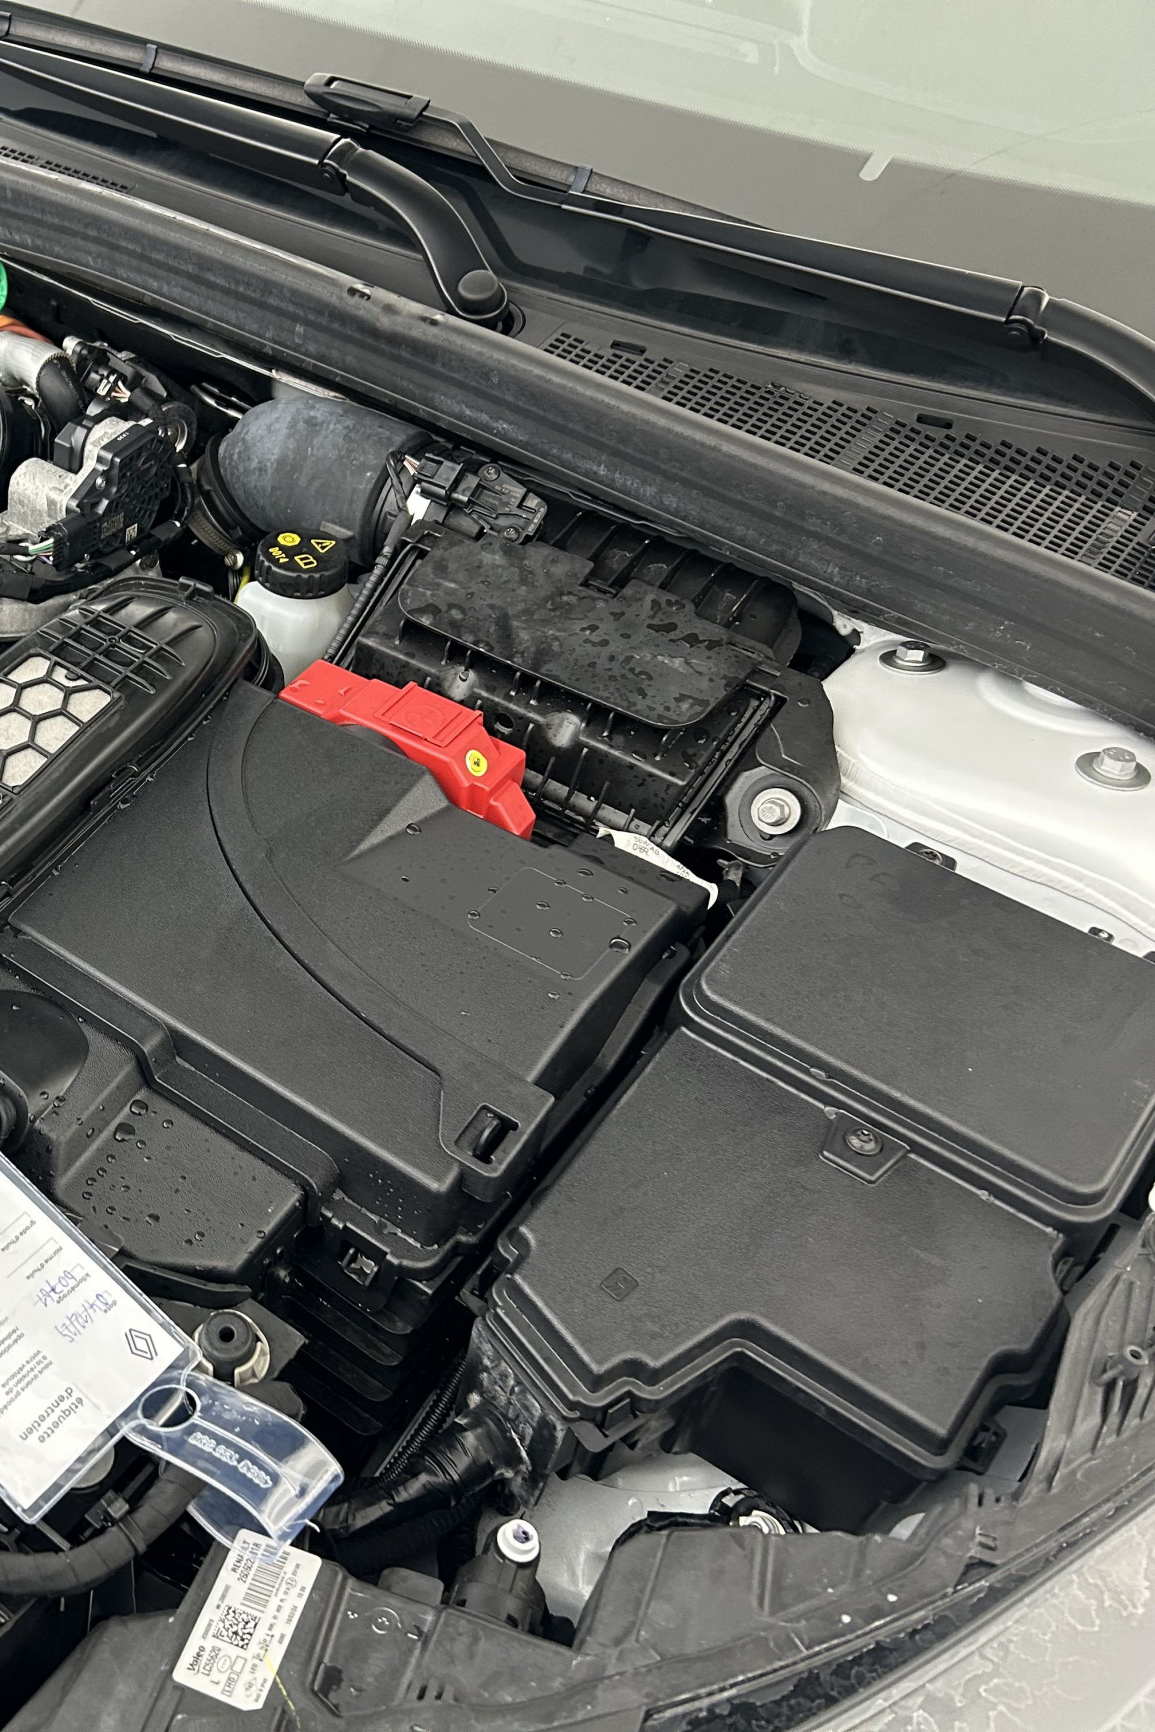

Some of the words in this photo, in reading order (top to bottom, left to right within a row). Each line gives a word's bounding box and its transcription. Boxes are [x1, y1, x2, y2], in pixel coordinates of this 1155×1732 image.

[17, 1218, 37, 1238] grade
[0, 1233, 21, 1255] d'huile
[42, 1244, 64, 1265] norme
[24, 1260, 46, 1282] d'huile
[54, 1271, 91, 1305] kilométrage
[101, 1298, 119, 1315] date
[24, 1347, 42, 1366] votre
[34, 1357, 44, 1367] la
[36, 1358, 54, 1376] nous
[0, 1362, 27, 1390] véhicule
[11, 1363, 38, 1389] révision
[18, 1371, 40, 1393] avons
[3, 1385, 15, 1397] de
[18, 1385, 76, 1444] d'entretien
[33, 1393, 86, 1446] étiquette
